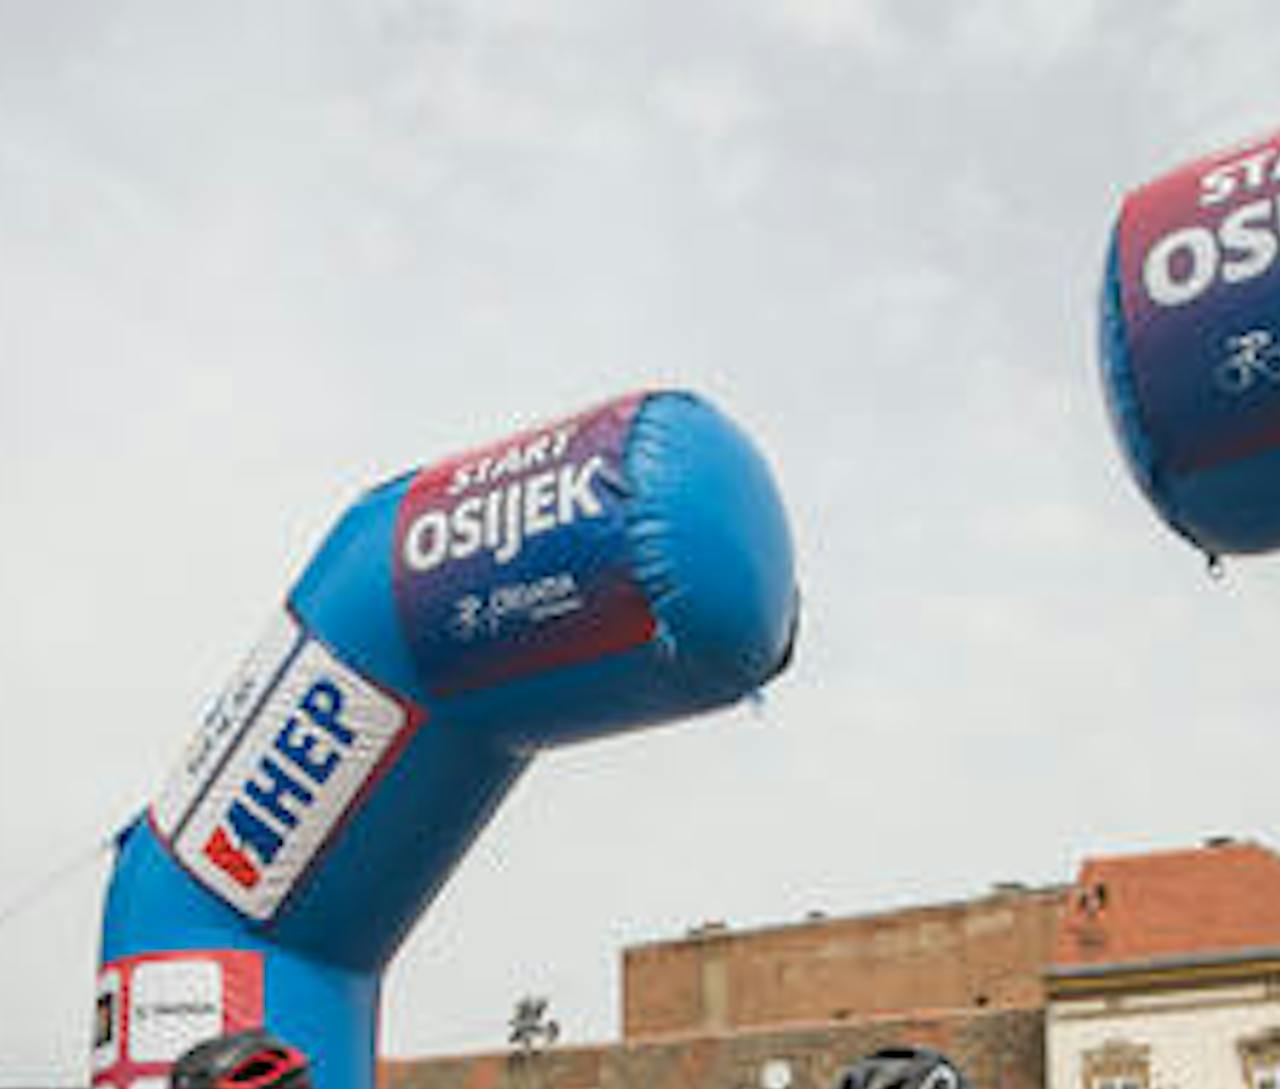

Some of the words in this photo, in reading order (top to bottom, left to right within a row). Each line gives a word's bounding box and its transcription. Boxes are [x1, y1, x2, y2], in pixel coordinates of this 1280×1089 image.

[404, 456, 603, 571] OSIJEK
[447, 424, 580, 495] START
[244, 678, 356, 829] HEP
